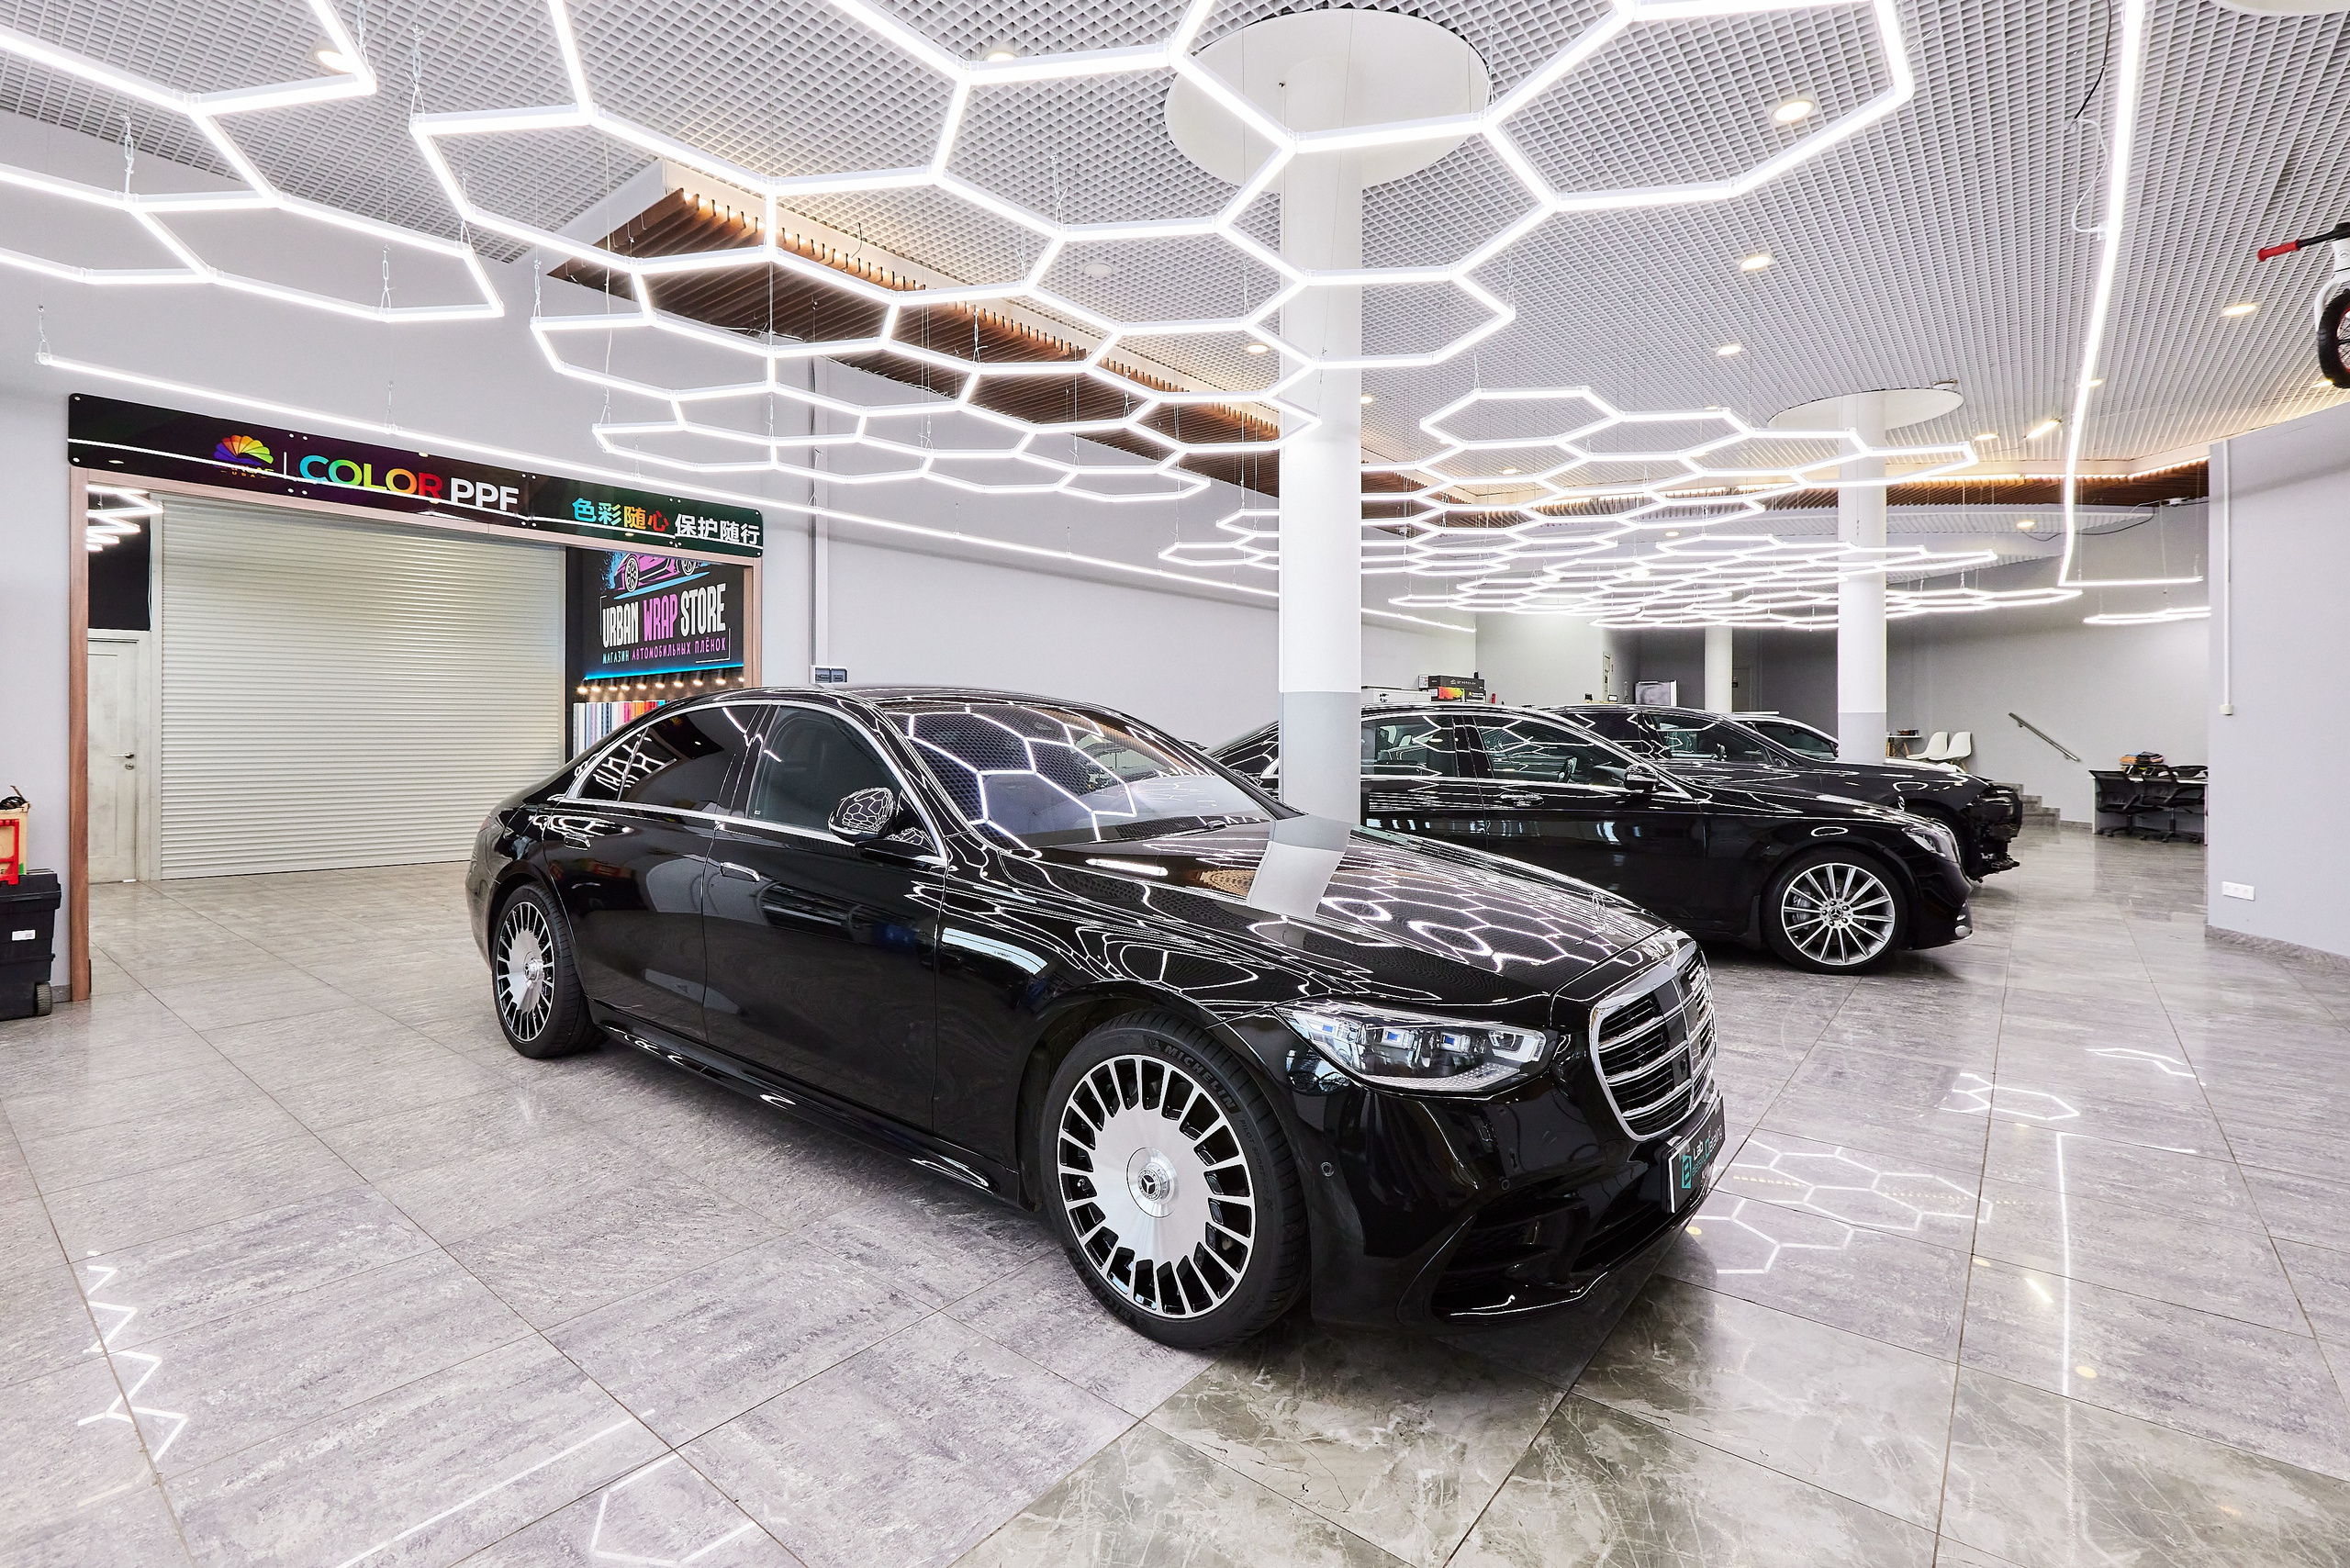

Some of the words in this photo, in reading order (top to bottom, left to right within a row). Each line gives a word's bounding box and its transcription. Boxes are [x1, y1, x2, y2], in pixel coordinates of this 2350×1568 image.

[298, 454, 443, 499] COLOR
[450, 477, 520, 510] PPF
[572, 498, 669, 532] 色彩随心
[674, 513, 760, 544] 保护随行
[602, 601, 639, 648] URBAN
[643, 594, 678, 641] WRAP
[680, 583, 726, 636] STORE
[602, 649, 630, 665] МАГАЗИН
[632, 642, 690, 661] АВТОМОБИЛЬНЫХ
[694, 637, 726, 654] ПЛЁНОК
[1164, 1044, 1237, 1109] MICHELIN
[1239, 1119, 1255, 1143] PILOT
[1693, 1139, 1704, 1160] Lab
